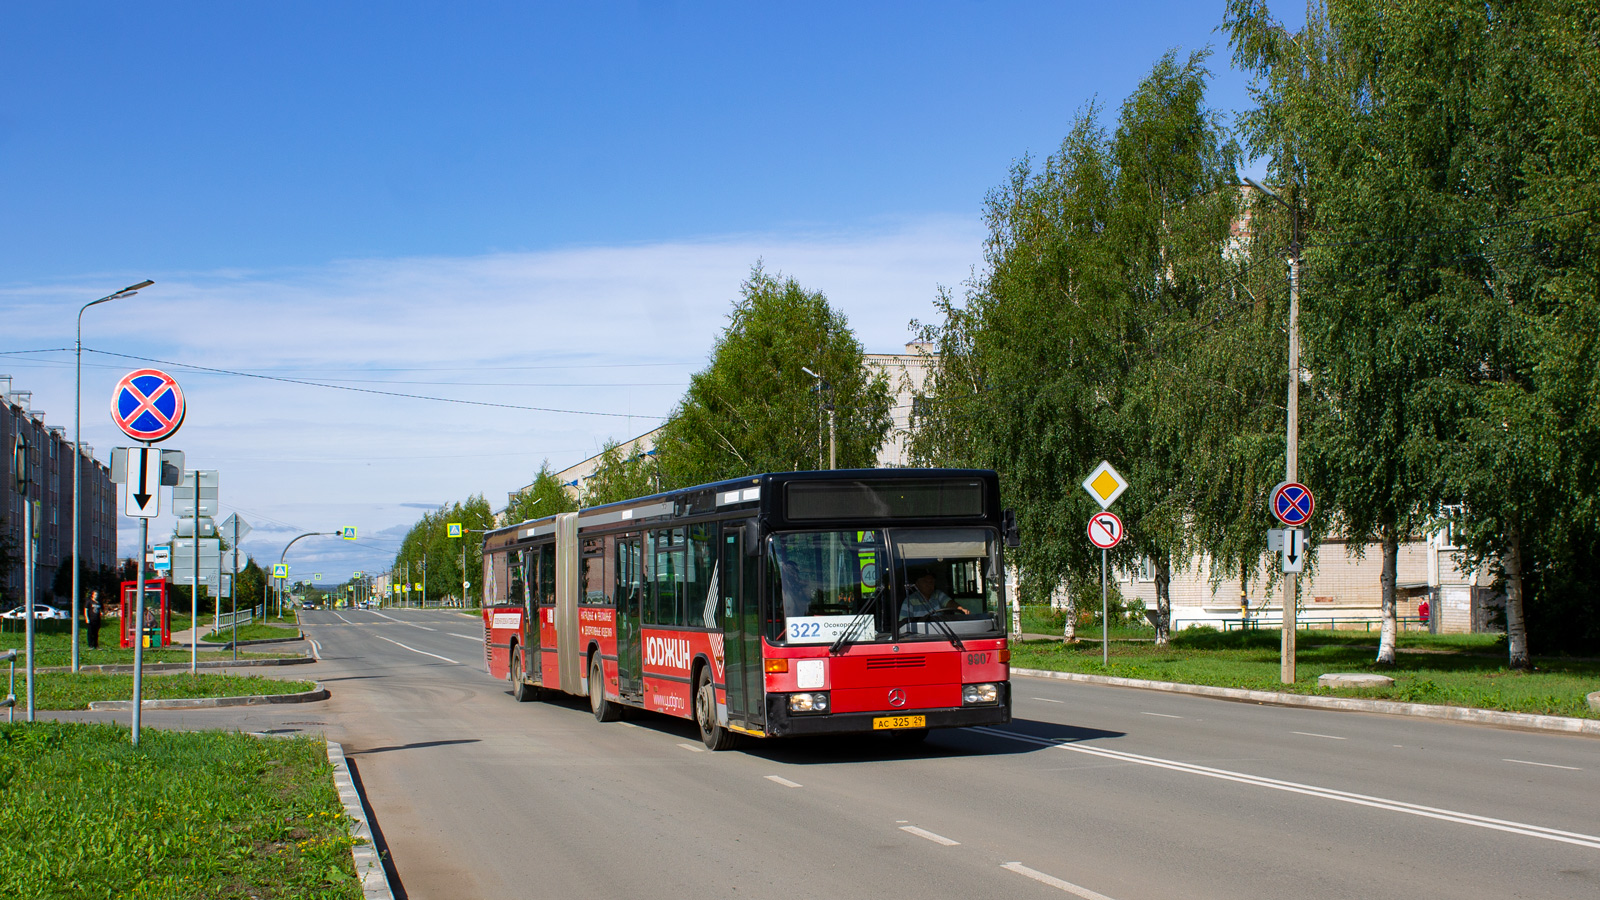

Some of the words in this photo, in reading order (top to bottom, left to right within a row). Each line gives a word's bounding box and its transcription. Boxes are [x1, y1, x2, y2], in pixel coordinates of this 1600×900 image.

[790, 622, 821, 638] 322
[646, 636, 691, 670] ЮДЖИН
[967, 652, 992, 665] 9907
[892, 717, 910, 727] 325
[913, 716, 923, 724] 29
